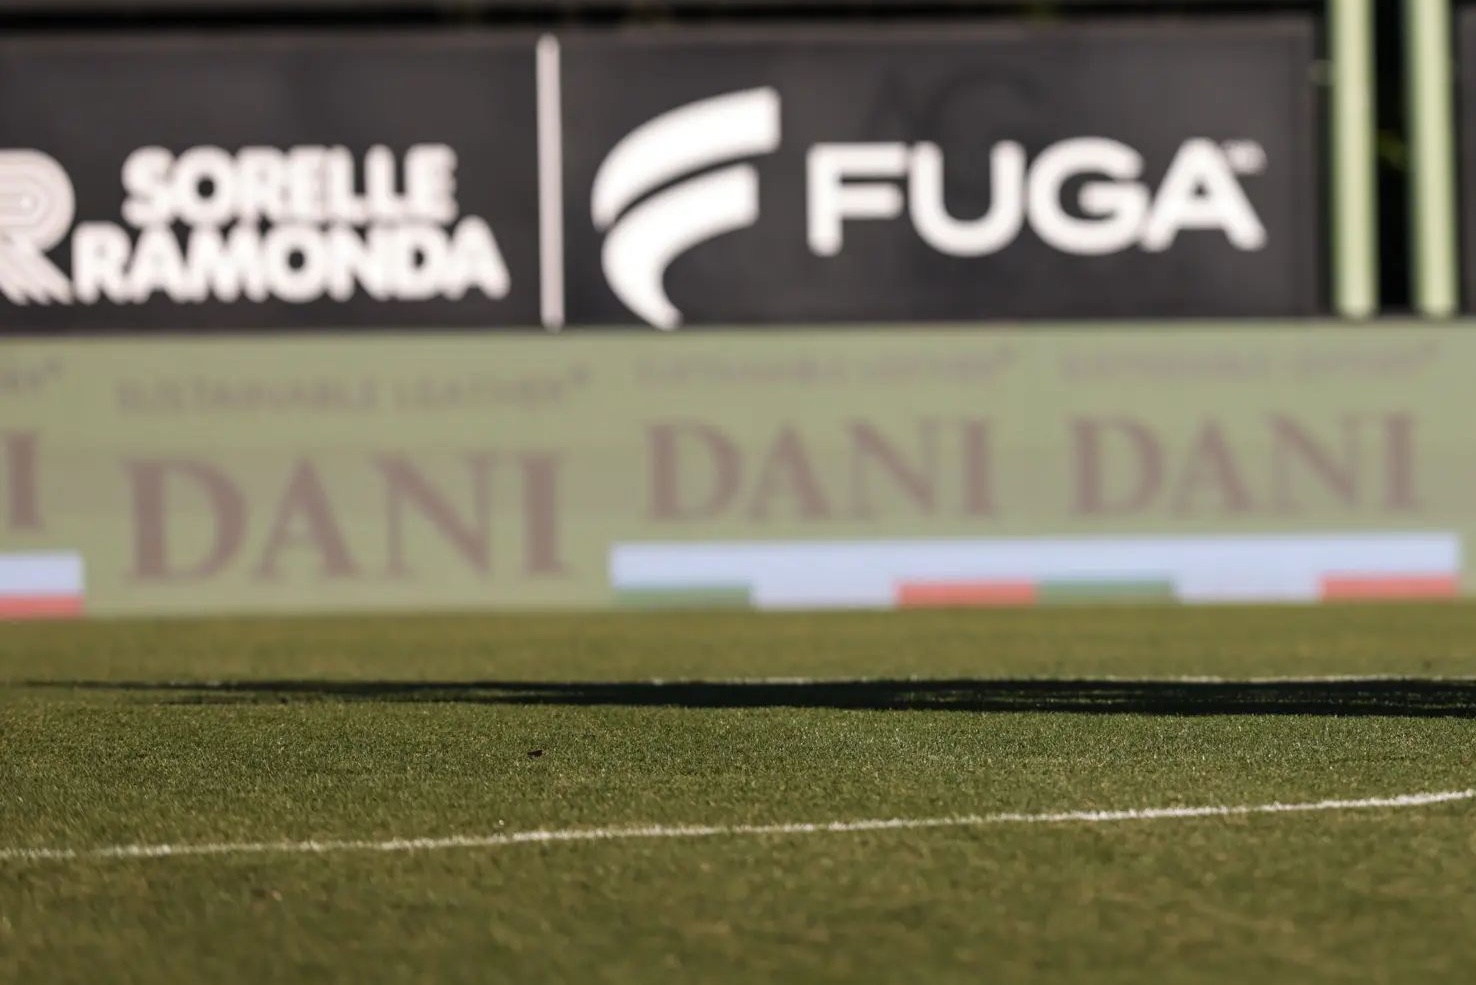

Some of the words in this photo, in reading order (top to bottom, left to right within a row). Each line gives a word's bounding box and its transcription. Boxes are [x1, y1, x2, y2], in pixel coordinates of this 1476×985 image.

[121, 144, 459, 228] SORELLE
[70, 216, 510, 304] RAMONDA
[642, 423, 999, 523] DANI
[1068, 411, 1421, 519] DANI
[118, 448, 572, 583] DANI
